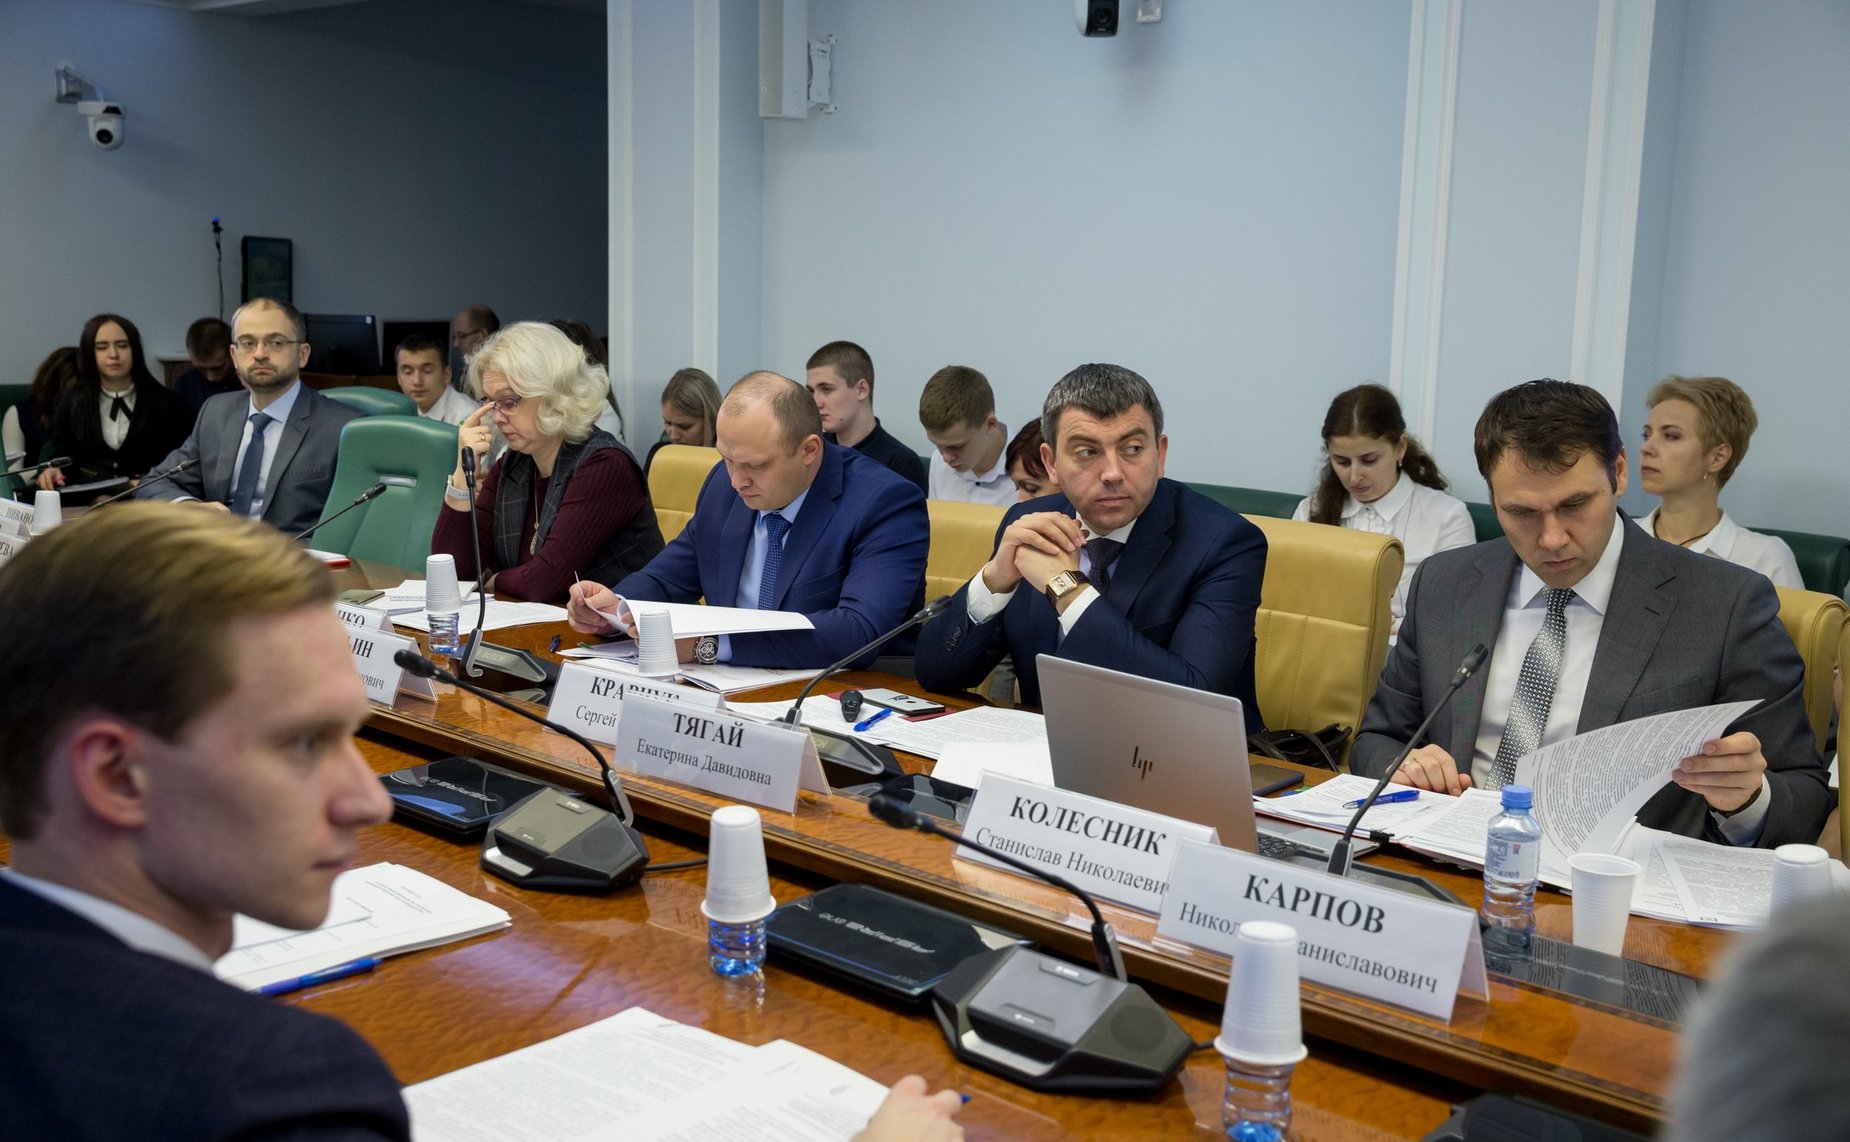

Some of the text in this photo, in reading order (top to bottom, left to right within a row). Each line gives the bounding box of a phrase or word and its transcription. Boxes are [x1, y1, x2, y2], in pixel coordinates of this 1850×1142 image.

[575, 704, 618, 727] Сергей
[673, 712, 746, 748] ТЯГАЙ
[636, 738, 772, 786] Екатерина Давидовна
[1010, 796, 1167, 856] КОЛЕСНИК
[976, 827, 1169, 895] Станислав Николаеви
[1243, 874, 1386, 934] КАРПОВ
[1179, 901, 1438, 994] Никол аниславович
